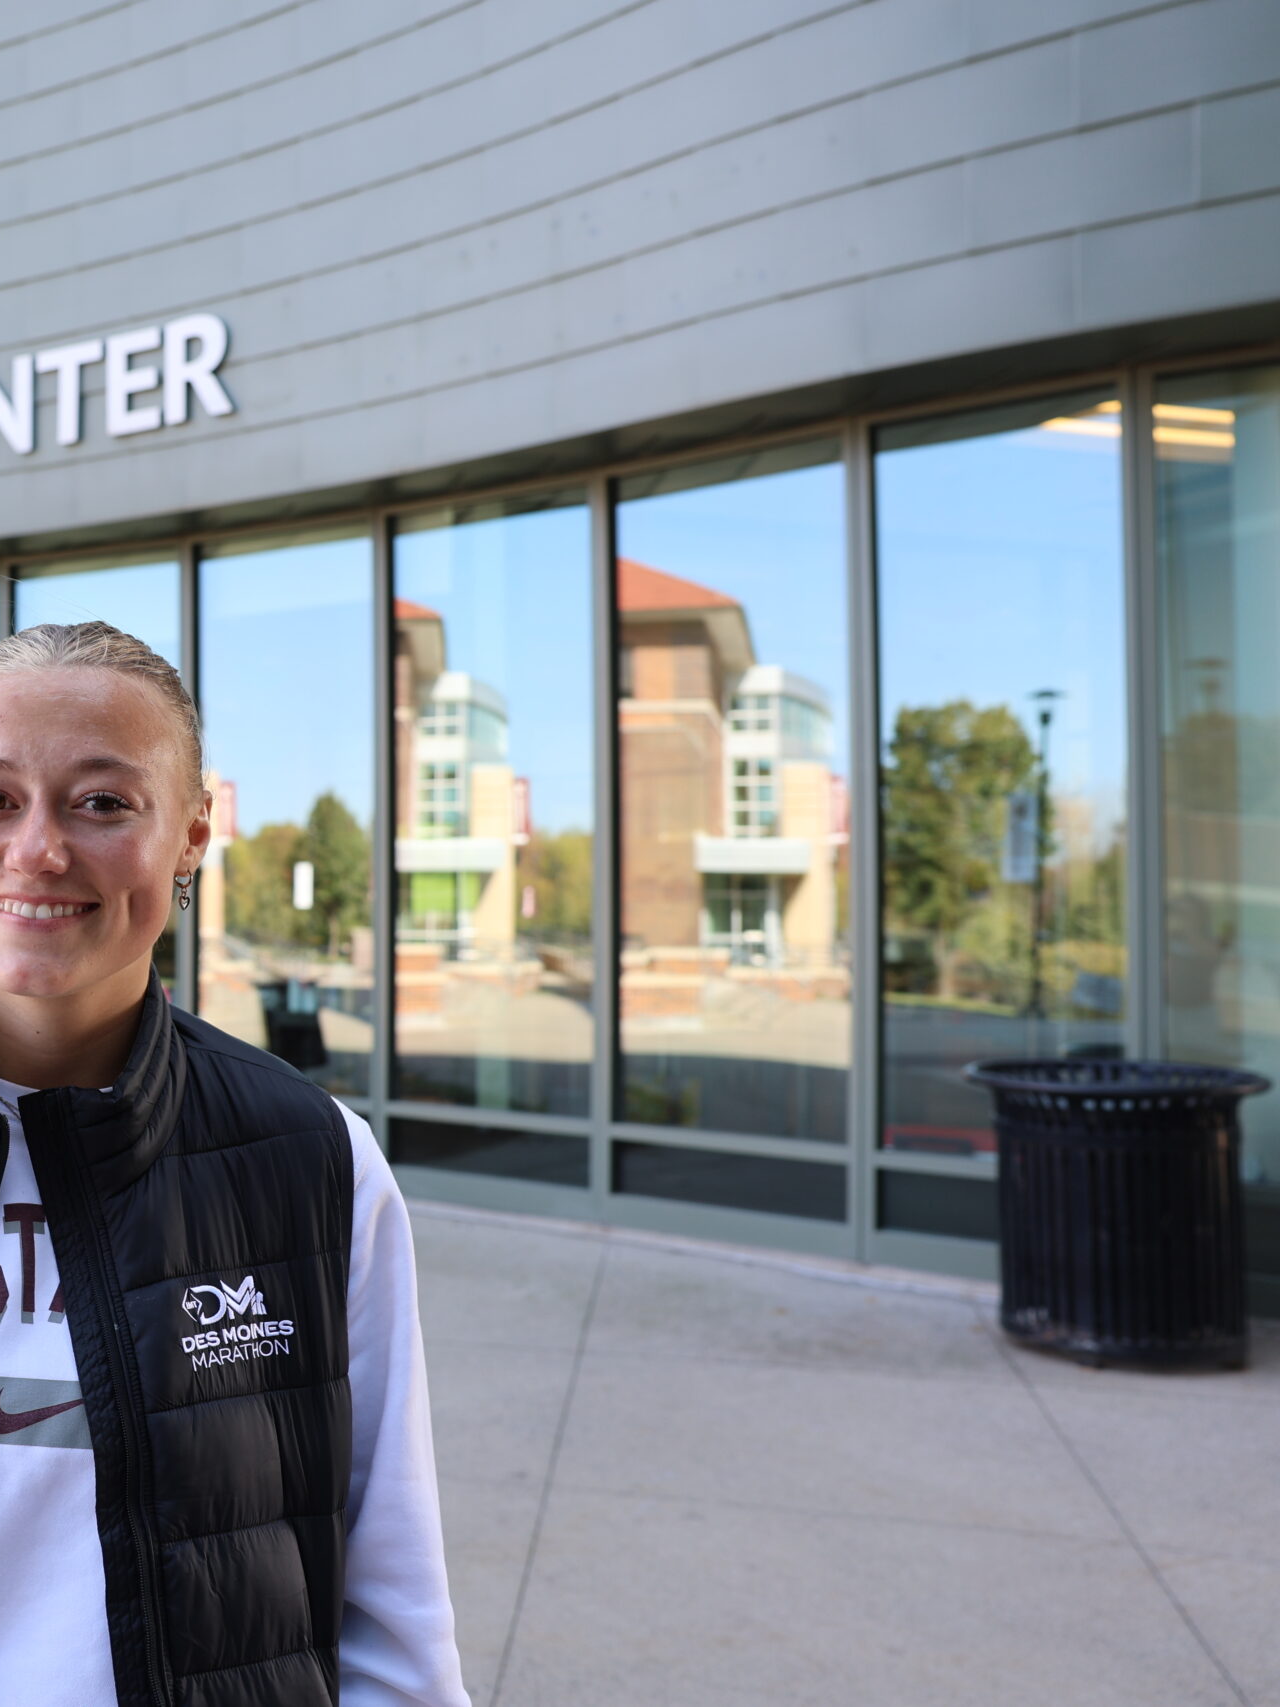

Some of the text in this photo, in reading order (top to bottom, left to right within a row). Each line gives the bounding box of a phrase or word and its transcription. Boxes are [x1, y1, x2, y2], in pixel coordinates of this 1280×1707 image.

[181, 1320, 295, 1353] DES MOINES
[191, 1339, 290, 1372] MARATHON
